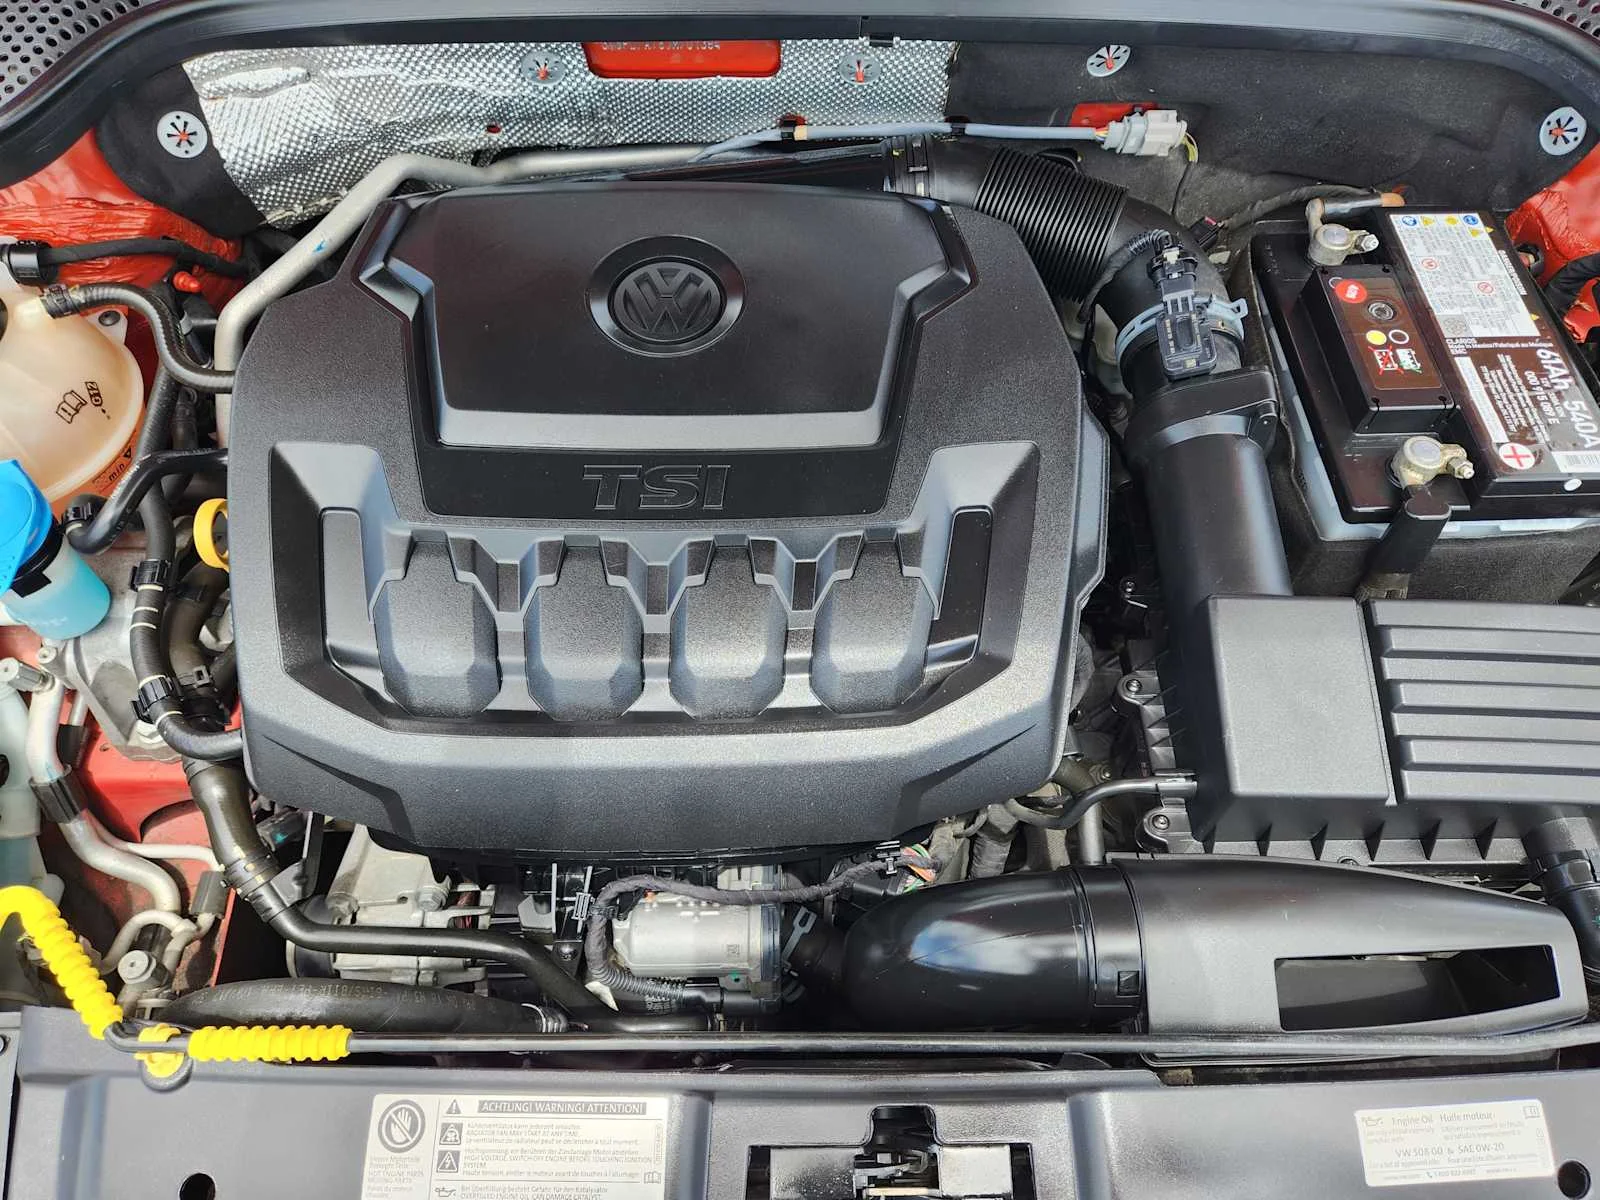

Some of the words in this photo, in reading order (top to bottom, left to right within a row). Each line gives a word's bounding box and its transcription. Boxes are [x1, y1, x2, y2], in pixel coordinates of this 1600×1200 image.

[1536, 348, 1576, 391] 61Ah
[1562, 400, 1600, 448] 540A
[583, 464, 731, 510] TSI
[481, 1101, 533, 1113] ACHTUNG!
[535, 1102, 585, 1113] WARNING!
[586, 1103, 643, 1114] ATTENTION!
